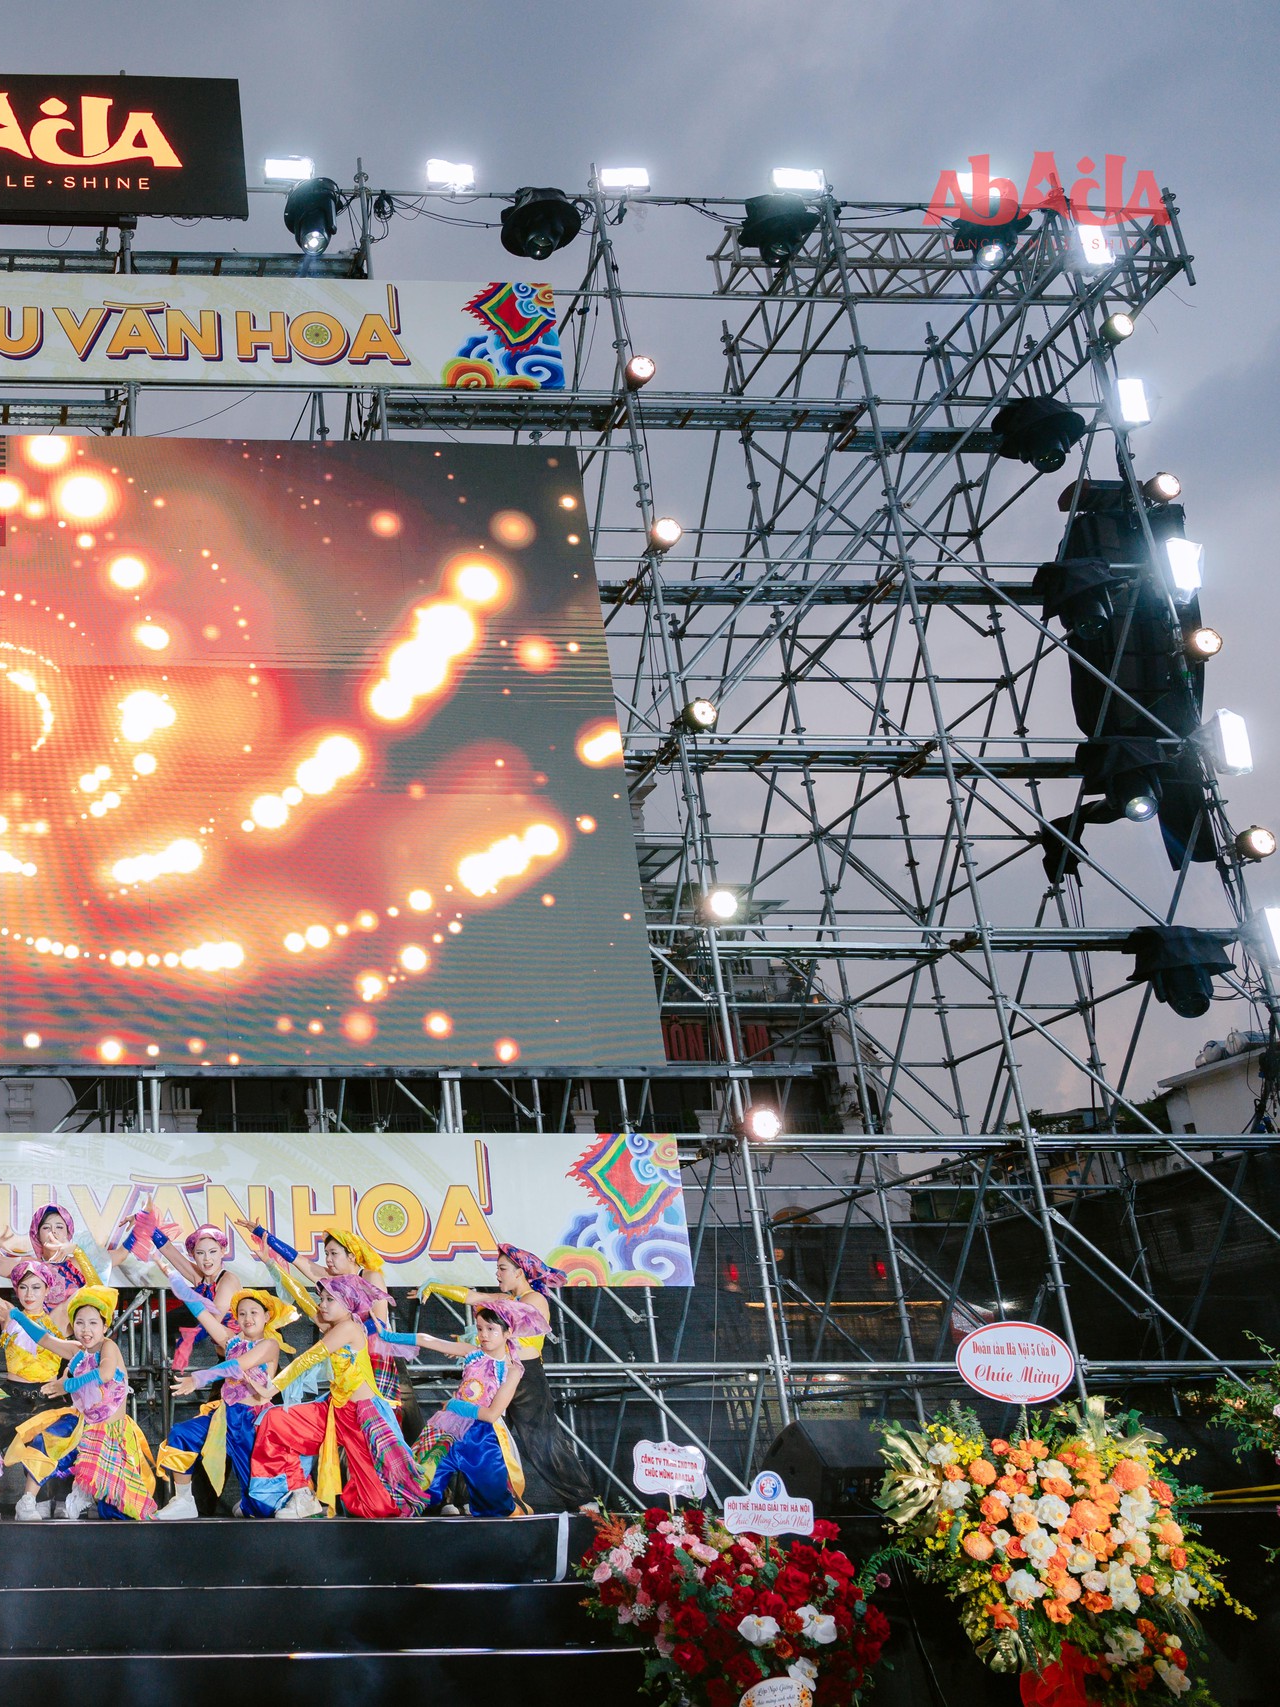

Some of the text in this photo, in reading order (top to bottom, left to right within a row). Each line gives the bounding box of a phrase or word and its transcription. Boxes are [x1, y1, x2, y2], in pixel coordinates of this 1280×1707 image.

[63, 176, 151, 190] SHINE
[52, 300, 222, 363] VĂN
[235, 283, 412, 367] HOÁ
[290, 1139, 501, 1264] HOÁ
[972, 1340, 1057, 1360] Đoàn tàu Hà Nội 5 Cửa Ô
[974, 1364, 1061, 1388] Chúc Mừng
[641, 1454, 654, 1464] CÔNG
[655, 1457, 662, 1466] TY
[645, 1467, 658, 1478] CHÚC
[659, 1469, 674, 1480] MỪNG
[727, 1499, 810, 1515] HỘI THỂ THAO GIẢI TRÍ HÀ NỘI
[726, 1512, 748, 1527] Chúc
[772, 1512, 790, 1527] Sinh
